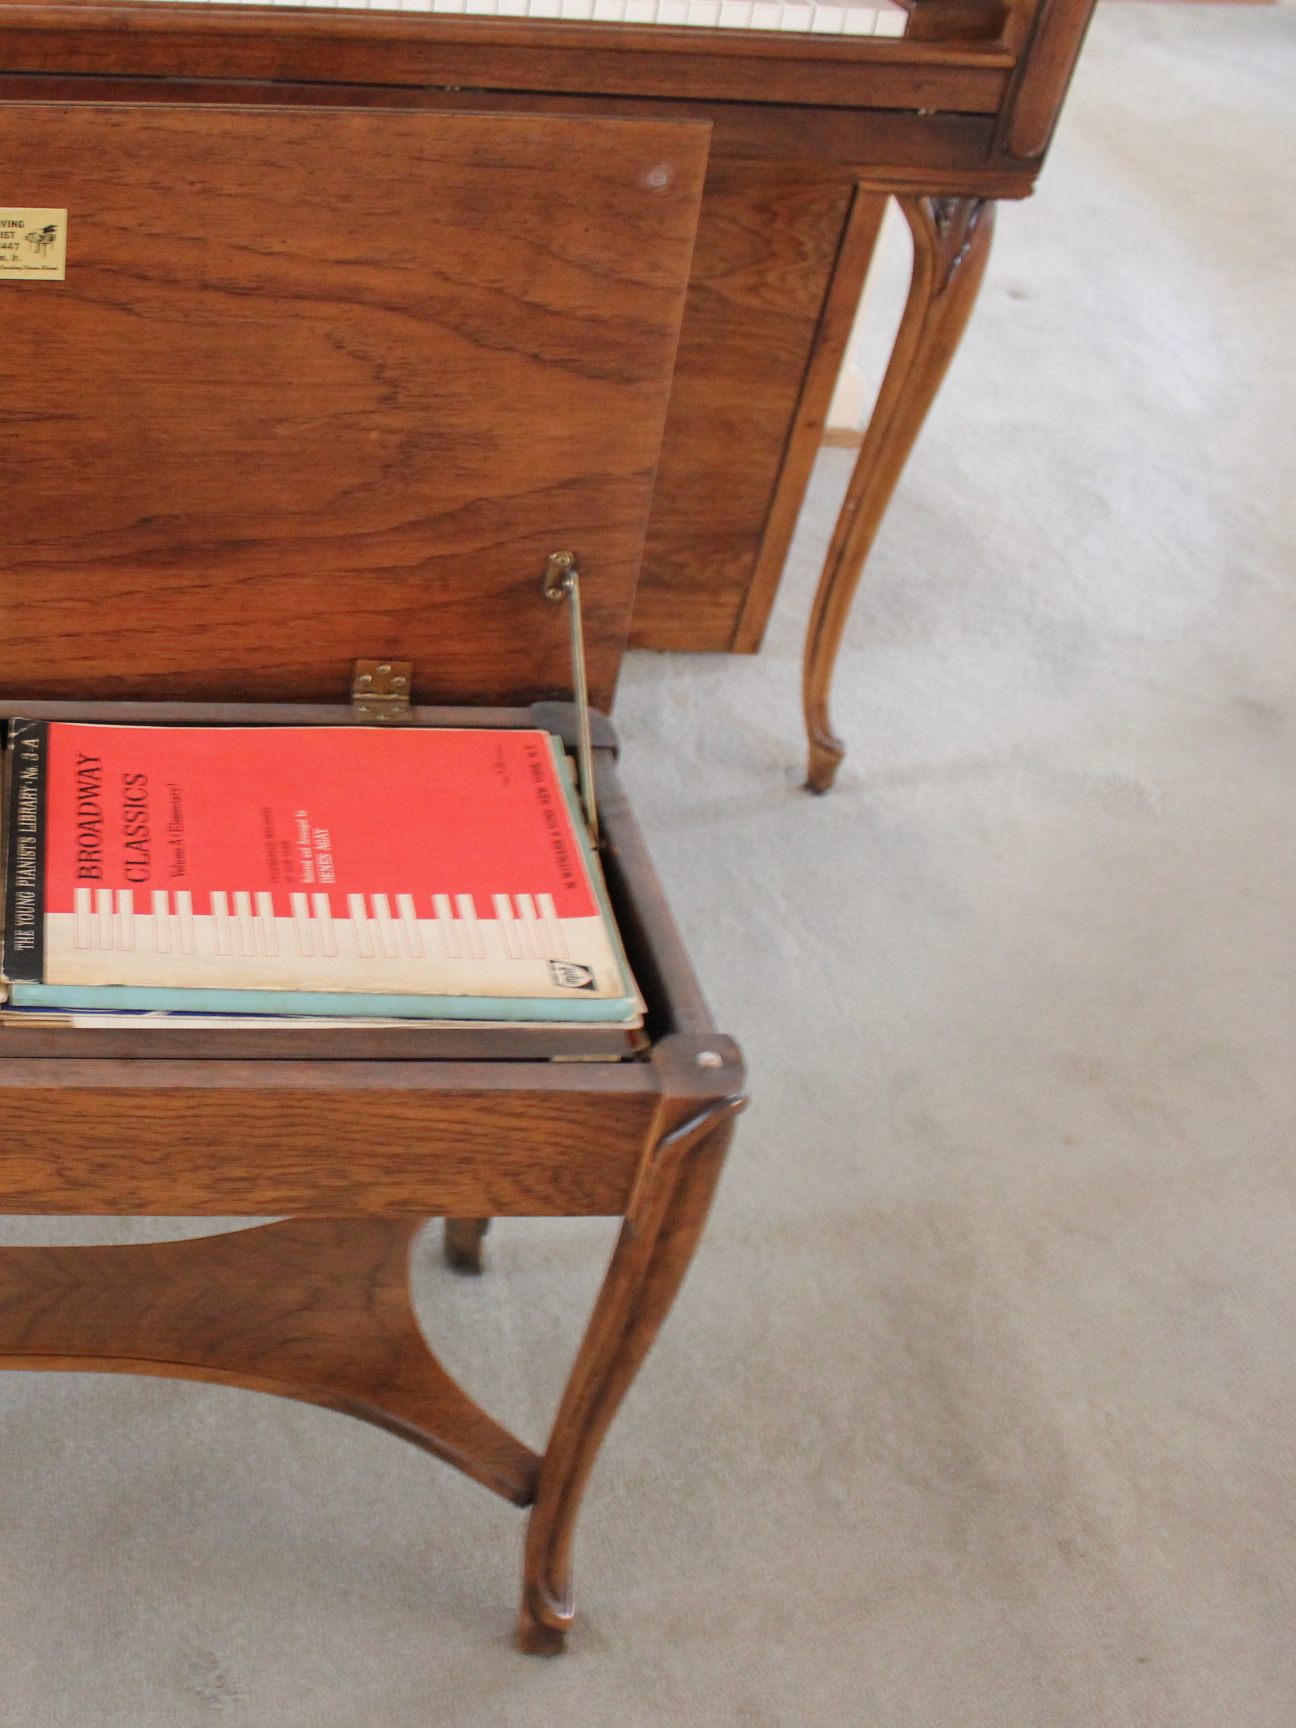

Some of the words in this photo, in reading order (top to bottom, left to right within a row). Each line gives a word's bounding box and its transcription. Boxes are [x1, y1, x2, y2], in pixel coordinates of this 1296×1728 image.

[18, 765, 39, 781] No.
[17, 785, 38, 834] LIBRARY
[77, 752, 103, 881] BROADWAY
[123, 773, 151, 884] CLASSICS
[311, 828, 332, 851] AGAY
[168, 847, 186, 878] Volume
[15, 890, 36, 927] YOUNG
[14, 930, 35, 951] THE
